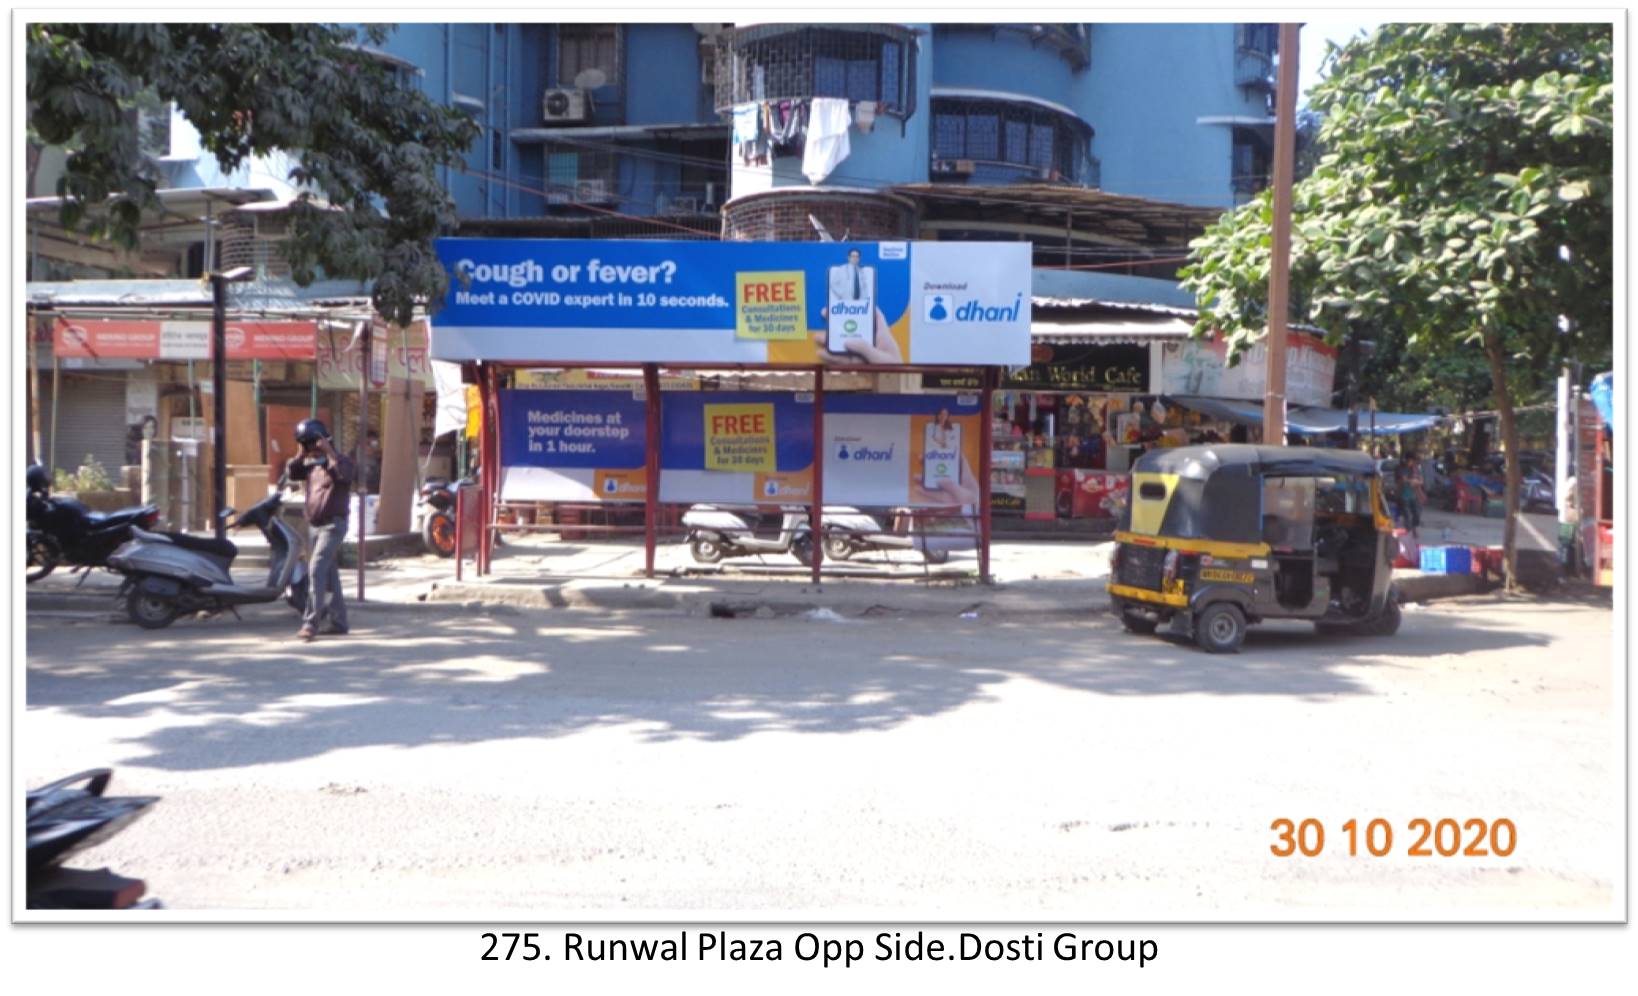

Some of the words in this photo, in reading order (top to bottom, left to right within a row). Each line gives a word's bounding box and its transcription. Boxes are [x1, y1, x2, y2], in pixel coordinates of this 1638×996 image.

[457, 259, 544, 287] Cough
[551, 265, 581, 283] or
[587, 259, 677, 284] fever?
[743, 281, 796, 303] FREE
[923, 282, 968, 291] Download
[456, 291, 494, 305] Meet
[498, 295, 508, 305] a
[512, 292, 560, 305] COVID
[564, 293, 614, 308] expert
[618, 293, 632, 306] in
[637, 293, 656, 306] 10
[660, 294, 729, 307] seconds.
[831, 298, 870, 315] dhani
[956, 291, 1023, 321] dhani
[1104, 366, 1141, 384] Cafe
[528, 410, 603, 424] Medicines
[606, 412, 622, 424] at
[711, 413, 766, 434] FREE
[528, 425, 561, 438] your
[528, 439, 543, 452] in
[547, 440, 556, 452] 1
[559, 440, 596, 453] hour.
[853, 442, 895, 461] dhani
